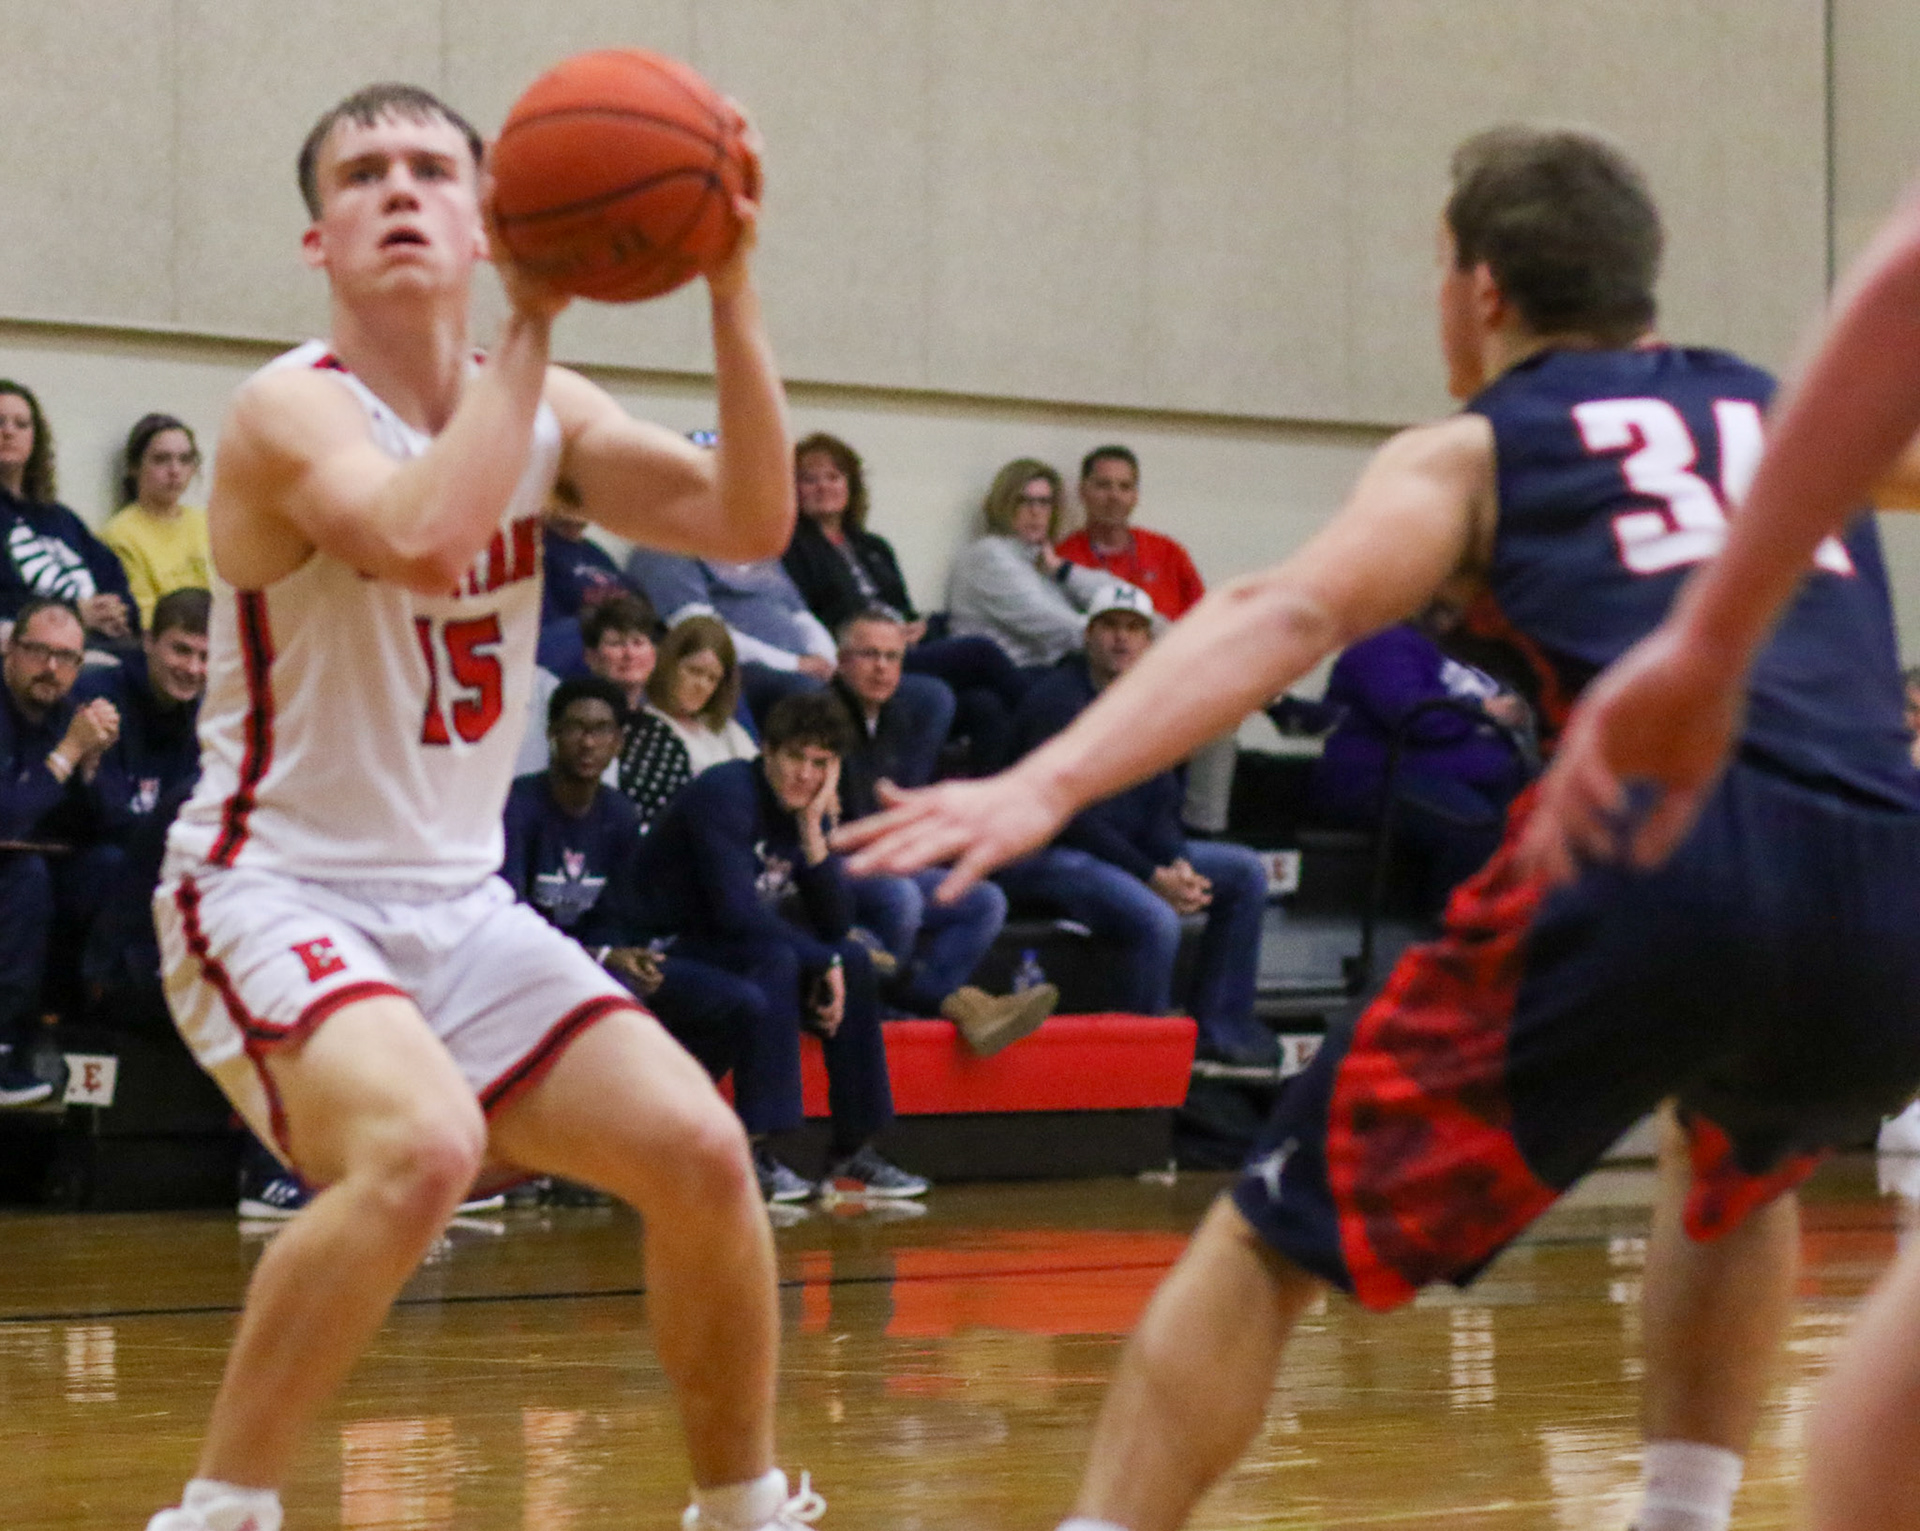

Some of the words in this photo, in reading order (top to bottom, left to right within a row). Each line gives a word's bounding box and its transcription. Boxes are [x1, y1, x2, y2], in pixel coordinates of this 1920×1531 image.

[413, 612, 503, 745] 15
[289, 936, 347, 983] E
[83, 1062, 103, 1092] E
